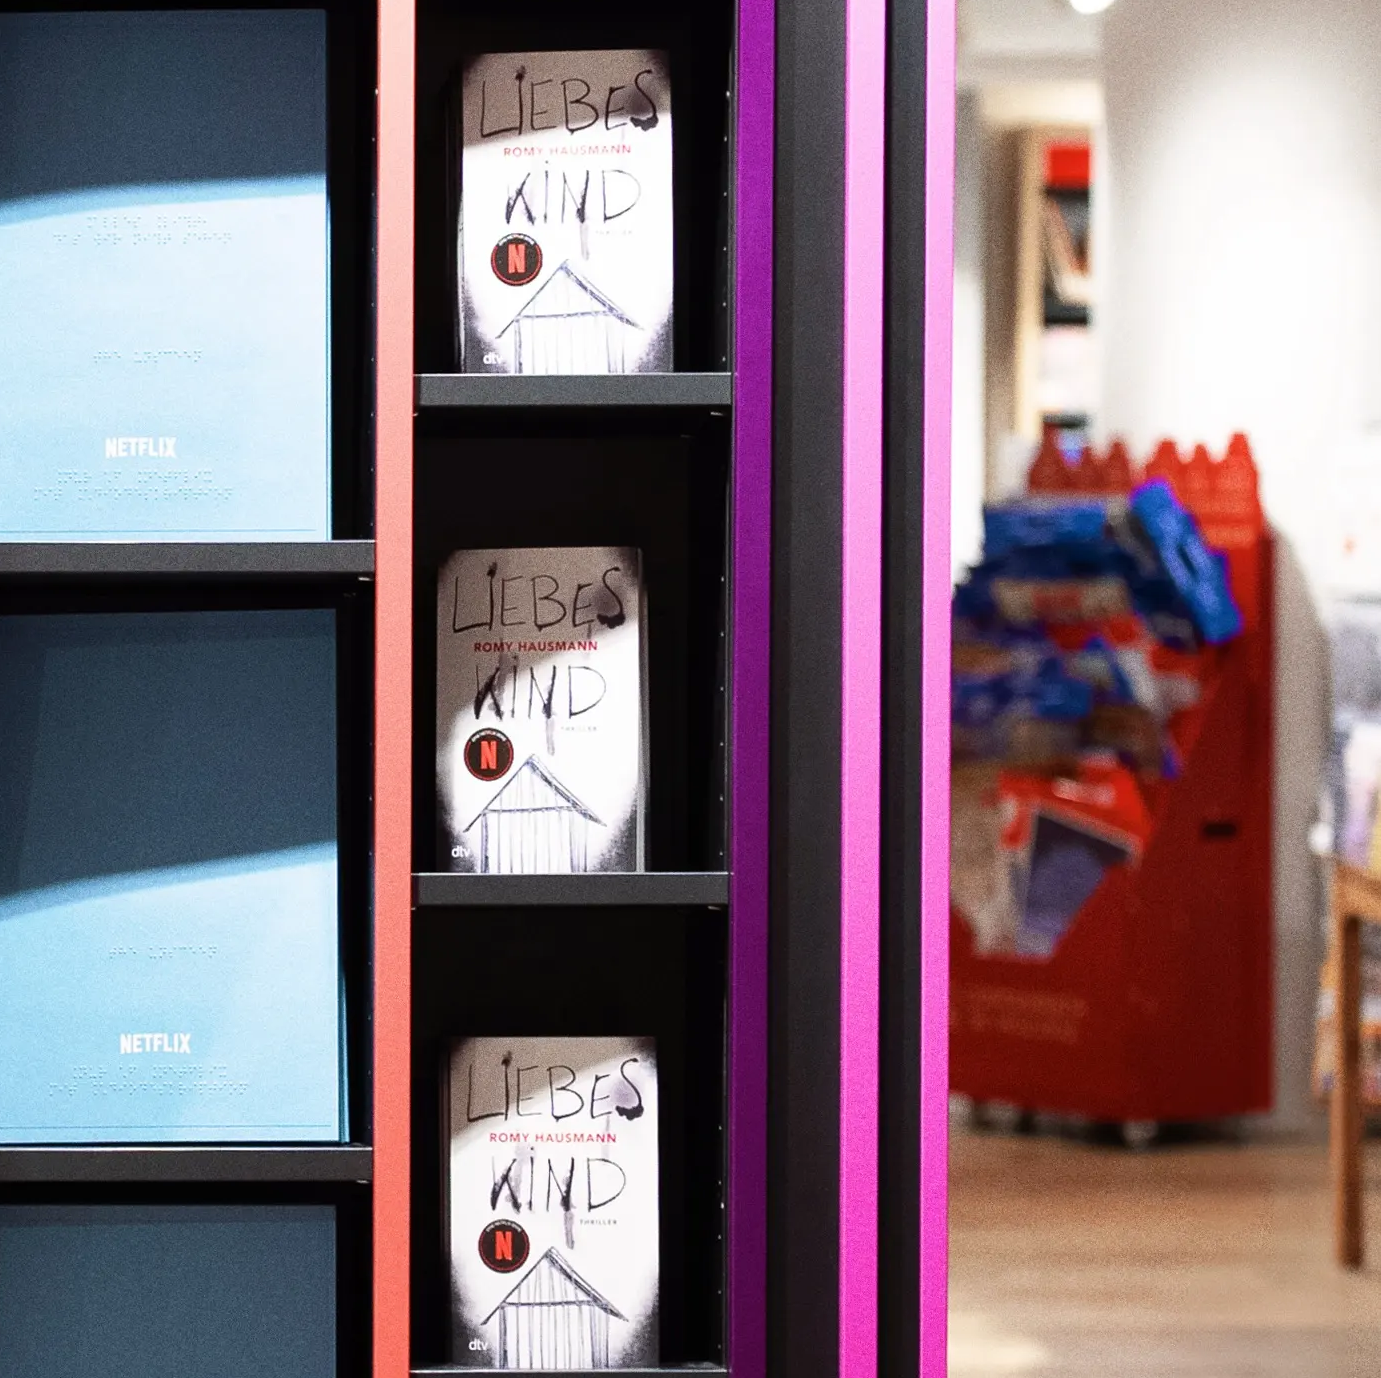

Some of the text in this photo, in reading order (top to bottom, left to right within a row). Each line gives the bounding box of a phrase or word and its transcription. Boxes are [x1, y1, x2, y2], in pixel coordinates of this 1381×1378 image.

[504, 145, 632, 157] ROMY HAUSMANN
[483, 352, 505, 365] dtv
[105, 436, 176, 459] NETFLIX
[474, 640, 598, 652] ROMY HAUSMANN
[451, 846, 470, 857] dtv
[120, 1033, 190, 1054] NETFLIX
[490, 1133, 617, 1143] ROMY HAUSMANN
[469, 1339, 488, 1351] dtv
